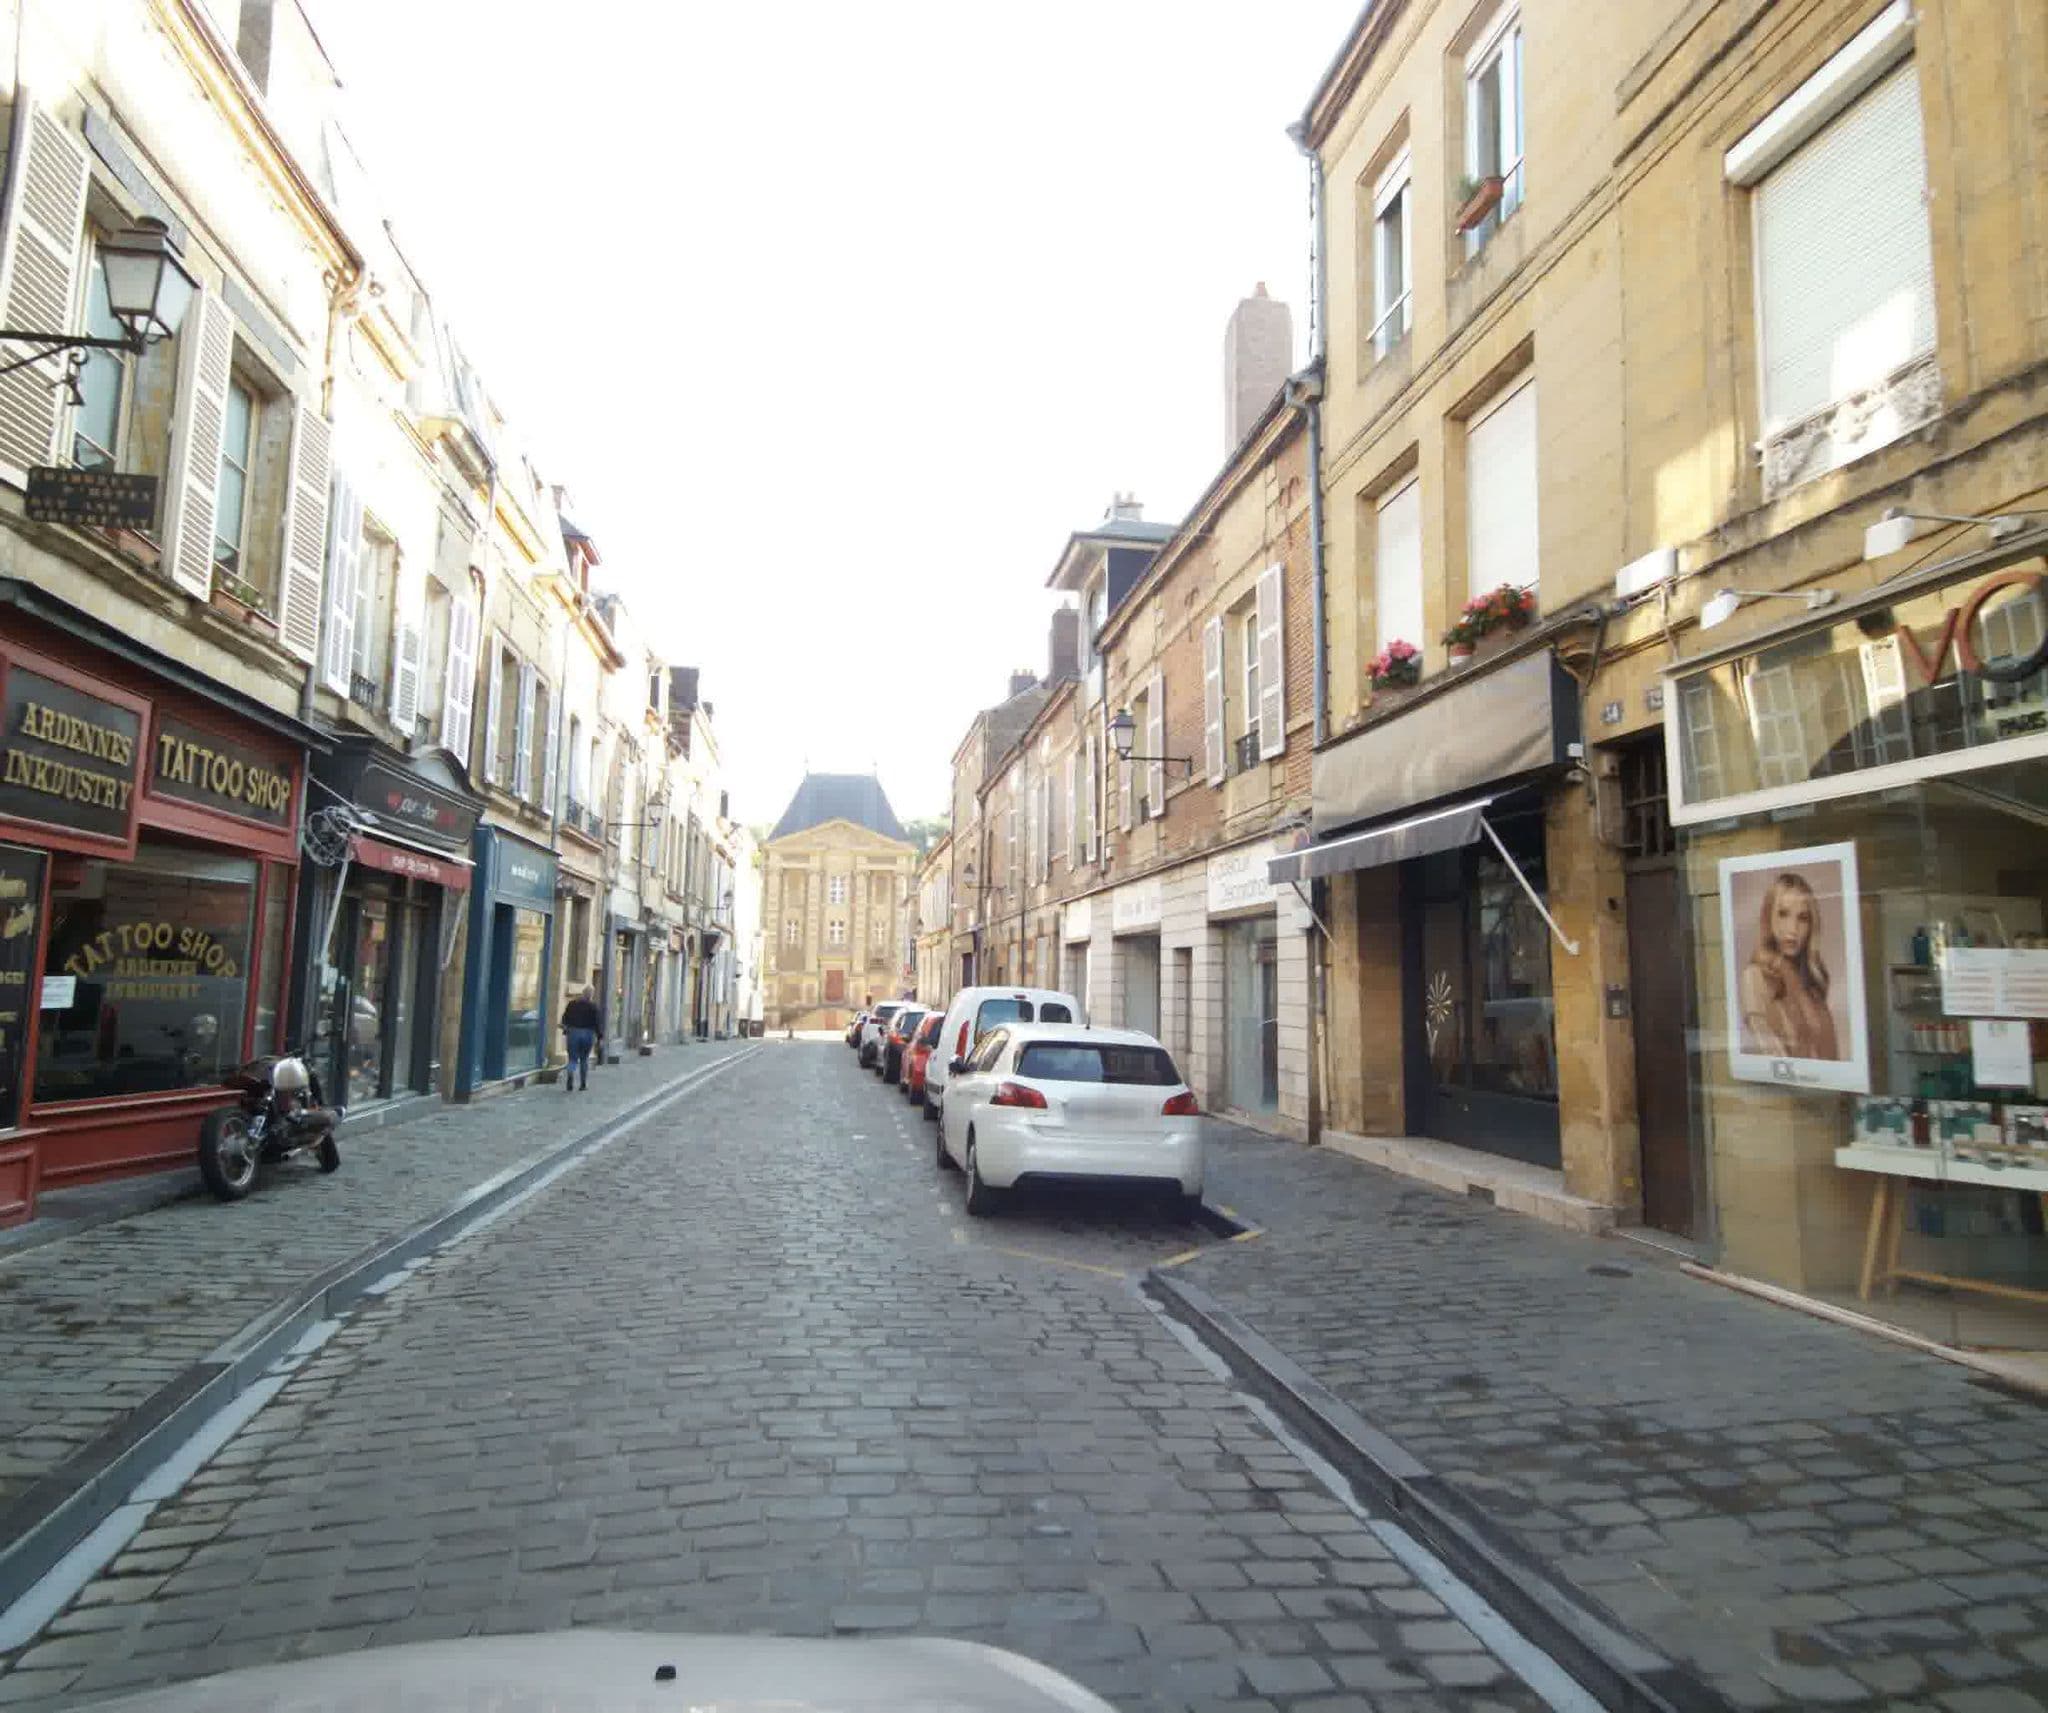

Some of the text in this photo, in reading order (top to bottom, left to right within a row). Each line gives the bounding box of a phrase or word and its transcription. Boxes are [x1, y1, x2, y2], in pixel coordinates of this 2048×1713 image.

[20, 702, 132, 767] ARDENNES
[4, 749, 132, 810] INKDUSTRY
[160, 734, 291, 814] TATTOO SHOP
[64, 922, 237, 977] TATTOO SHOP
